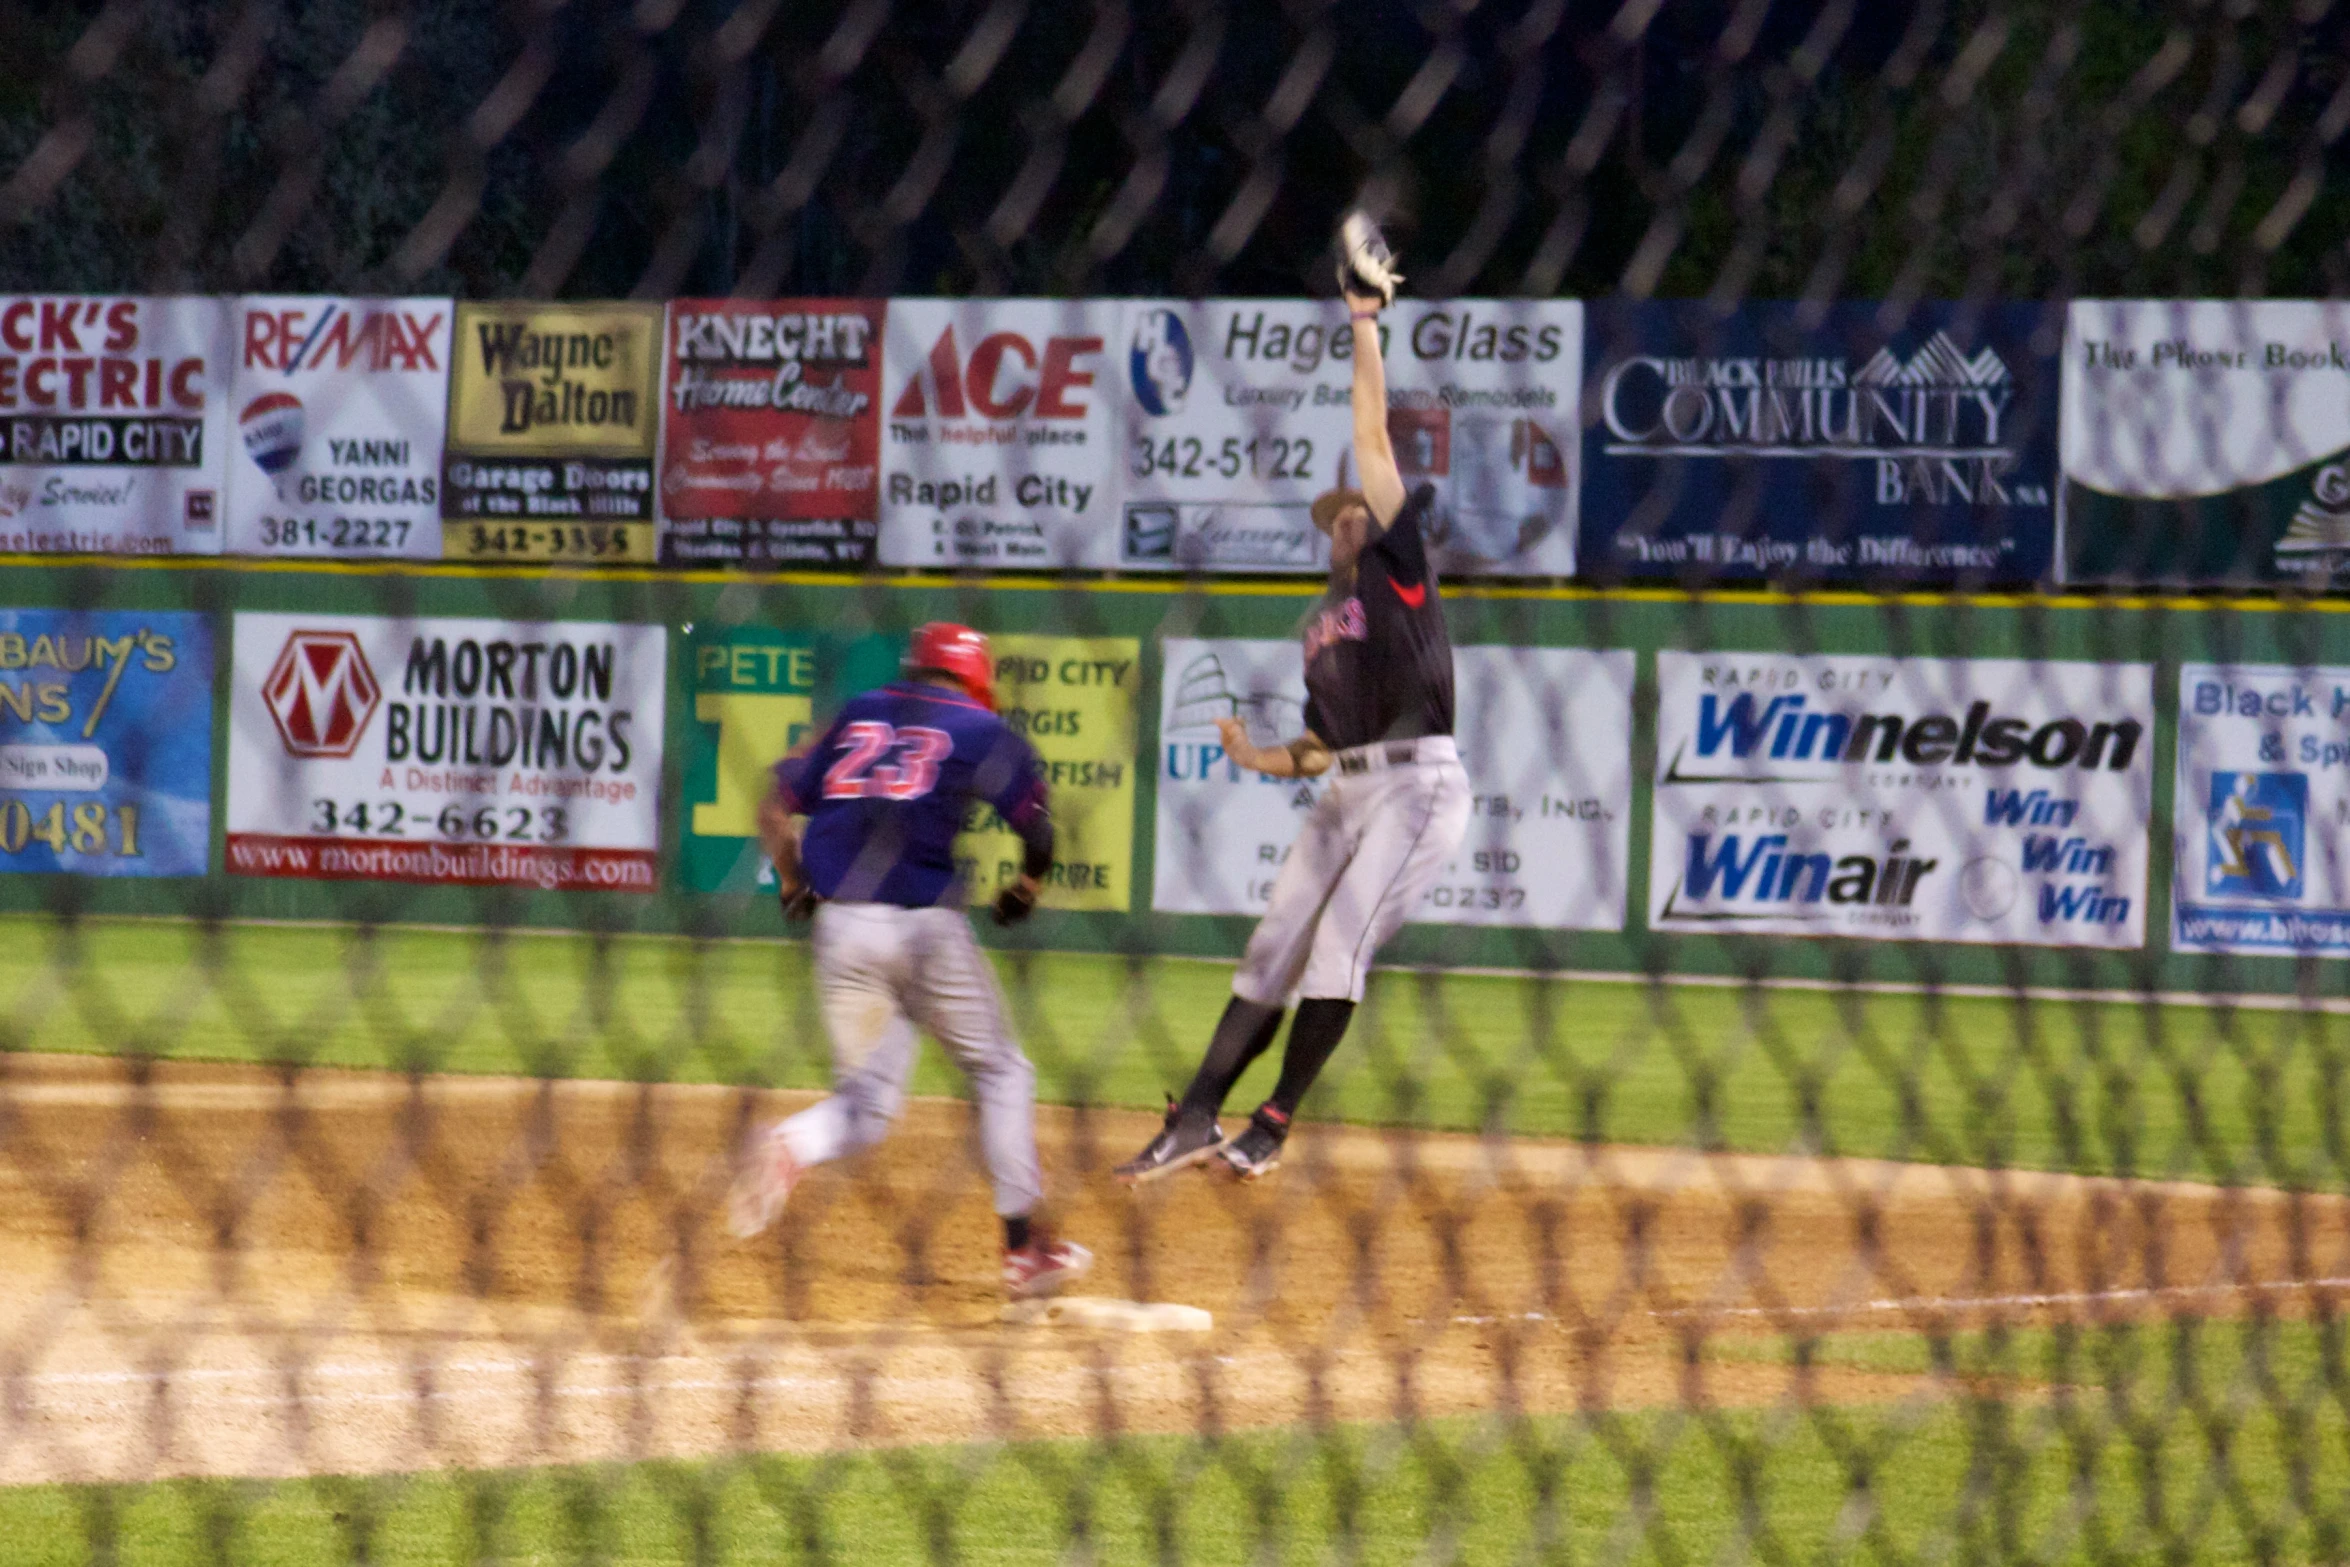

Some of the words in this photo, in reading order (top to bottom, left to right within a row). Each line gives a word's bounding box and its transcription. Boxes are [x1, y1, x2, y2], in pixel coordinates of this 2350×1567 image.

[244, 304, 442, 376] RE/MAX
[477, 322, 613, 387] Wayne
[676, 313, 869, 363] KNECHT
[1410, 312, 1562, 363] Glass
[891, 322, 1104, 419] ACE
[1664, 357, 1761, 388] BLACK
[501, 380, 636, 433] Dalton
[1223, 384, 1307, 412] Luxury
[1602, 355, 2012, 443] COMMUNITY
[12, 422, 114, 460] RAPID
[123, 424, 200, 462] CITY
[329, 439, 411, 468] YANNI
[890, 423, 929, 444] The
[1026, 424, 1088, 446] place
[451, 463, 554, 494] Garage
[563, 463, 650, 491] Doors
[1132, 436, 1314, 480] 342-5122
[301, 476, 437, 505] GEORGAS
[888, 472, 997, 512] Rapid
[1015, 472, 1094, 514] City
[1876, 457, 2012, 505] BANK
[260, 517, 412, 549] 381-2227
[403, 637, 615, 701] MORTON
[698, 644, 814, 687] PETE
[1059, 660, 1131, 687] CITY
[1702, 667, 1798, 689] RAPID
[1818, 668, 1894, 690] CITY
[2194, 680, 2313, 719] Black
[385, 703, 632, 773] BUILDINGS
[1696, 691, 2144, 772] Winnelson
[54, 756, 103, 781] Shop
[821, 718, 955, 801] 23
[379, 768, 395, 790] A
[406, 768, 497, 795] Distinct
[510, 772, 637, 806] Advantage
[1982, 788, 2080, 828] Win
[0, 801, 143, 857] 0481
[311, 798, 570, 842] 342-6623
[1703, 804, 1800, 829] RAPID
[1819, 808, 1894, 830] CITY
[1684, 834, 1938, 906] Winair
[2021, 835, 2116, 876] Win
[2037, 882, 2131, 925] Win
